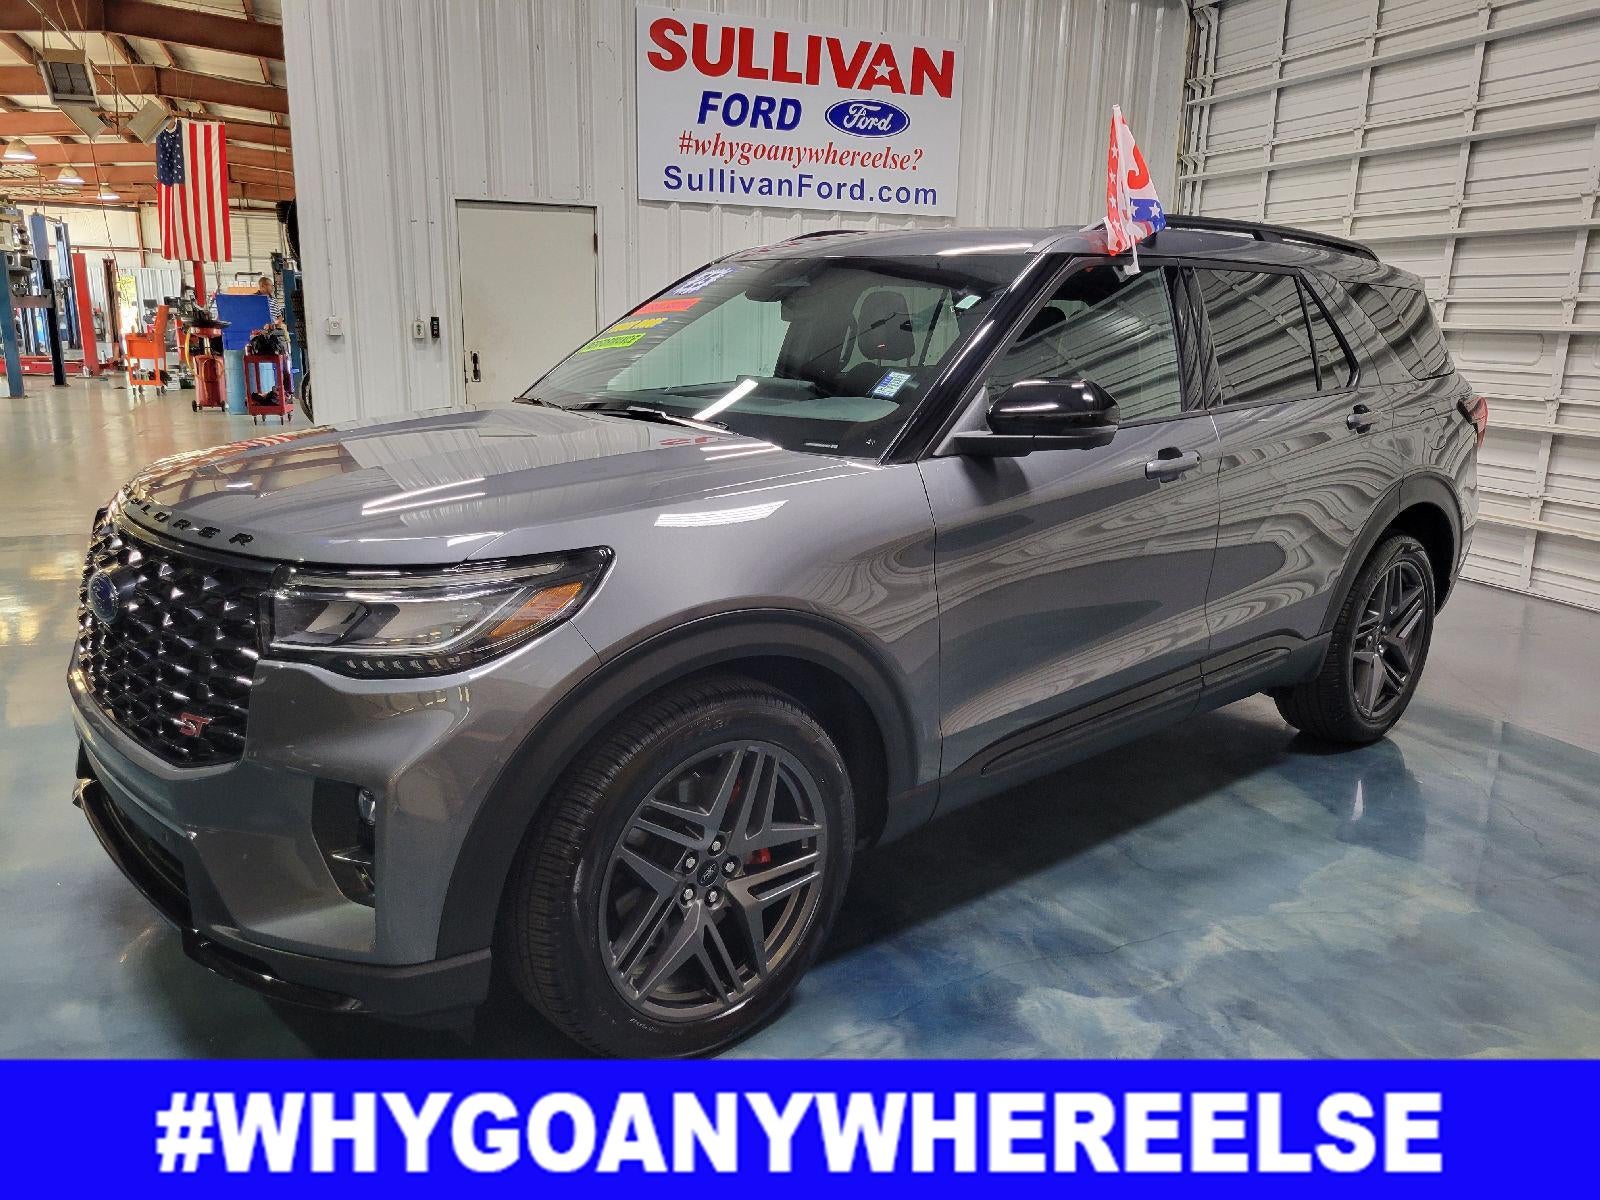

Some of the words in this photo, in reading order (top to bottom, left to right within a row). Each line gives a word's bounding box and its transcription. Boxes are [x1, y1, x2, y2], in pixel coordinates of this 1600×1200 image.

[646, 17, 955, 99] SULLIVAN
[697, 90, 802, 132] FORD
[678, 129, 924, 171] #whygoanywhereelse?
[663, 165, 937, 206] SullivanFord.com
